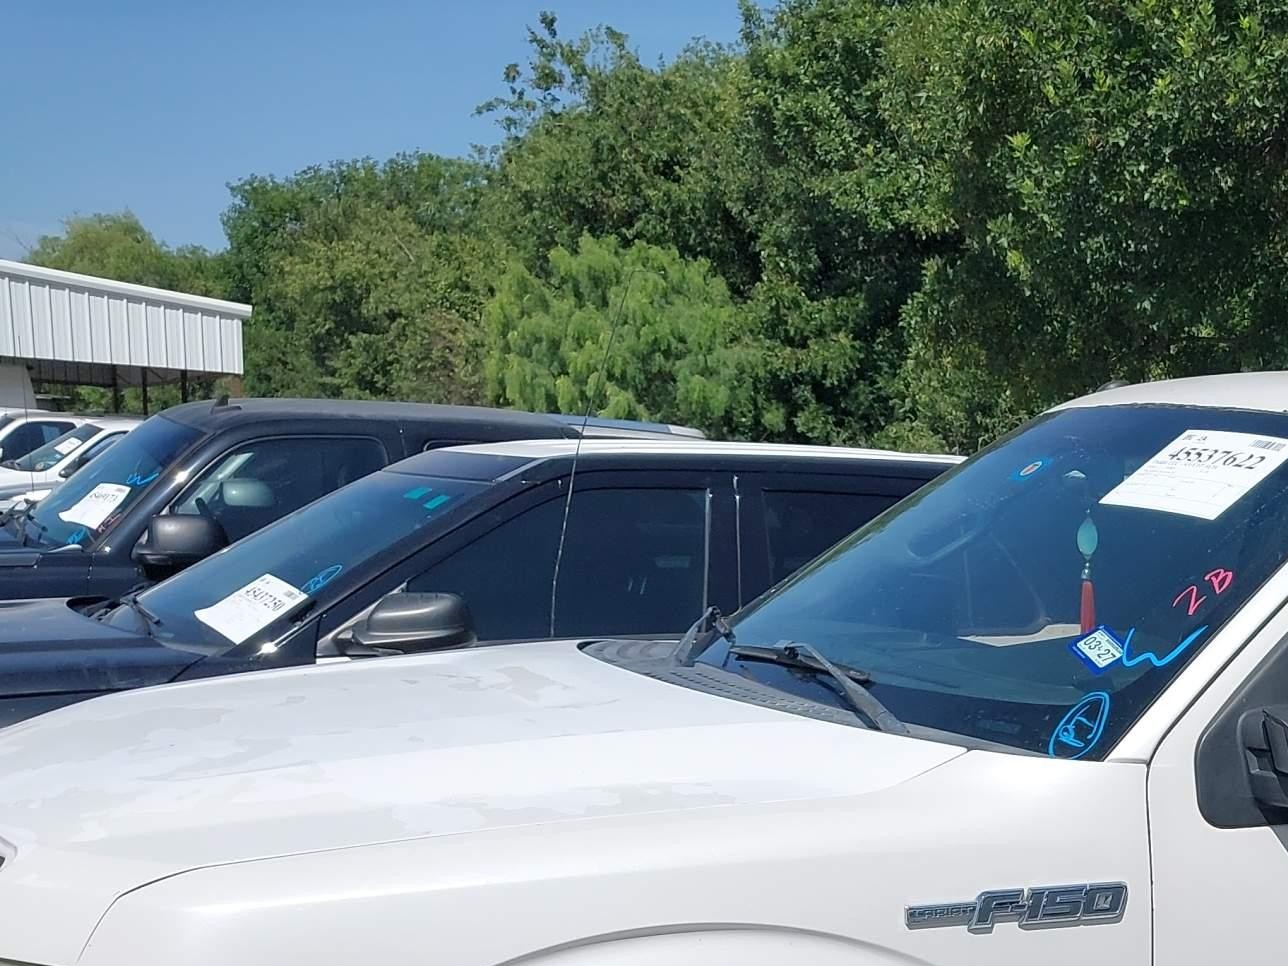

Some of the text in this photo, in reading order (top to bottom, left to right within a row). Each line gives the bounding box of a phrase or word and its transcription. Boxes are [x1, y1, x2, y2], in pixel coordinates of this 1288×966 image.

[1168, 446, 1267, 470] 45537622
[1083, 636, 1102, 650] 03
[1097, 649, 1117, 662] 27
[968, 881, 1129, 935] F-150
